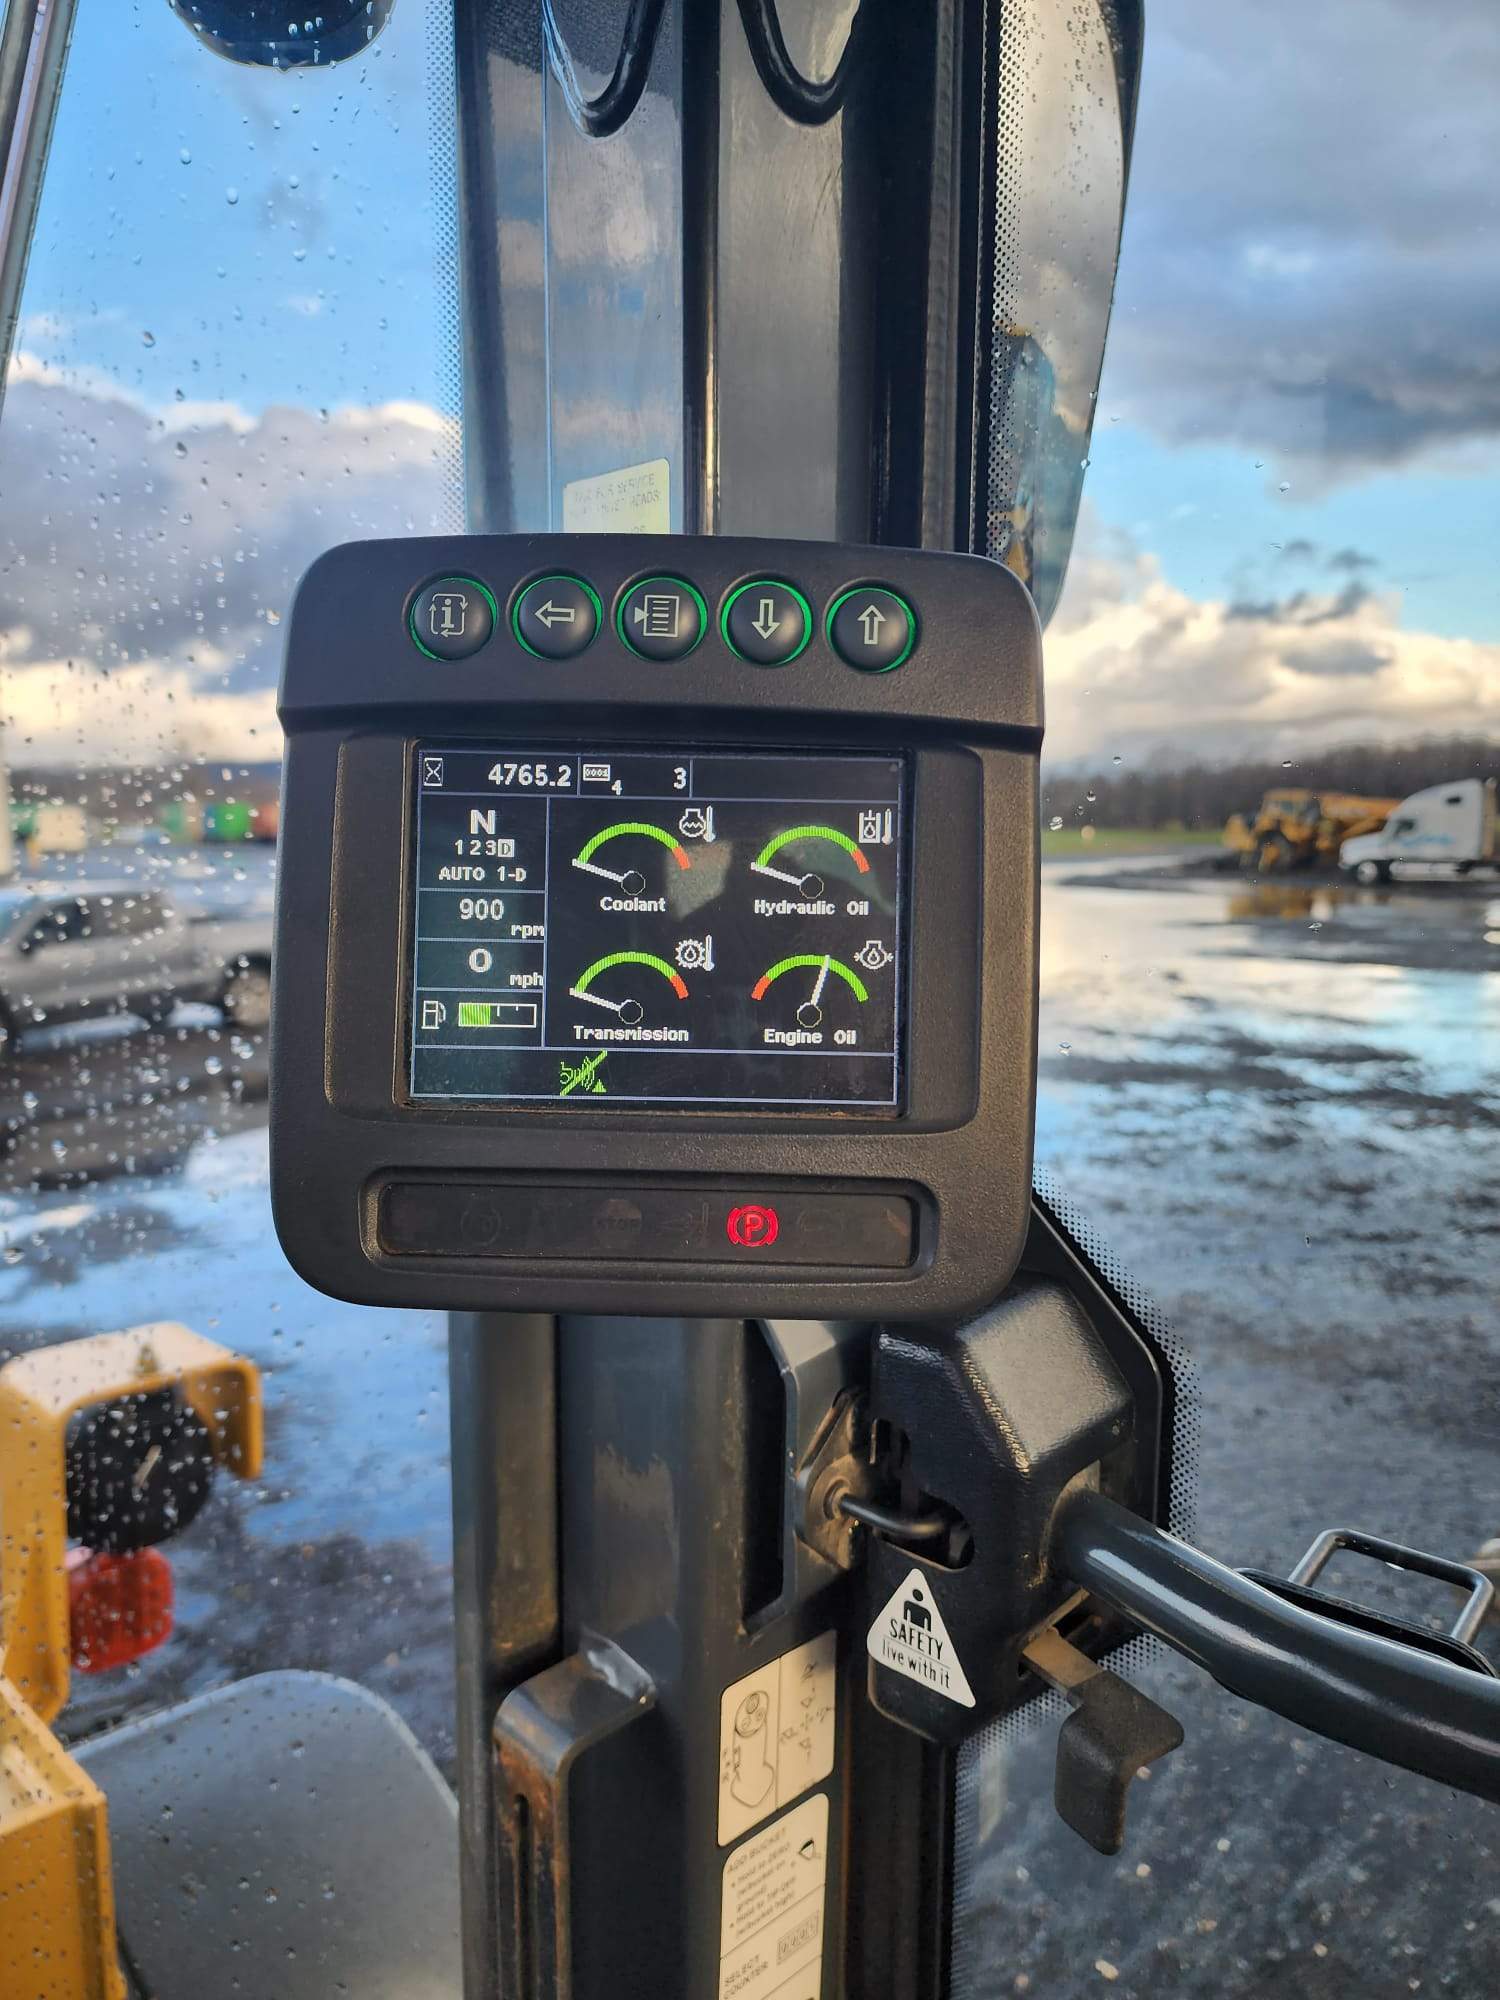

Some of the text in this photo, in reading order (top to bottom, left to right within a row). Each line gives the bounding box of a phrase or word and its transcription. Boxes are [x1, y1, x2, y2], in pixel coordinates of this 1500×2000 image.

[487, 763, 572, 787] 4765.2
[611, 767, 687, 796] 4 3
[470, 809, 496, 835] N
[438, 866, 527, 882] AUTO 1-D
[459, 898, 505, 921] 900
[599, 896, 666, 913] Coolant
[754, 899, 869, 917] Hydraulic Oil
[511, 924, 545, 939] rpm
[509, 972, 544, 988] mph
[573, 1025, 689, 1043] Transmission
[764, 1028, 857, 1047] Engine Oil
[890, 1618, 944, 1661] SAFETY
[882, 1639, 951, 1689] live with it
